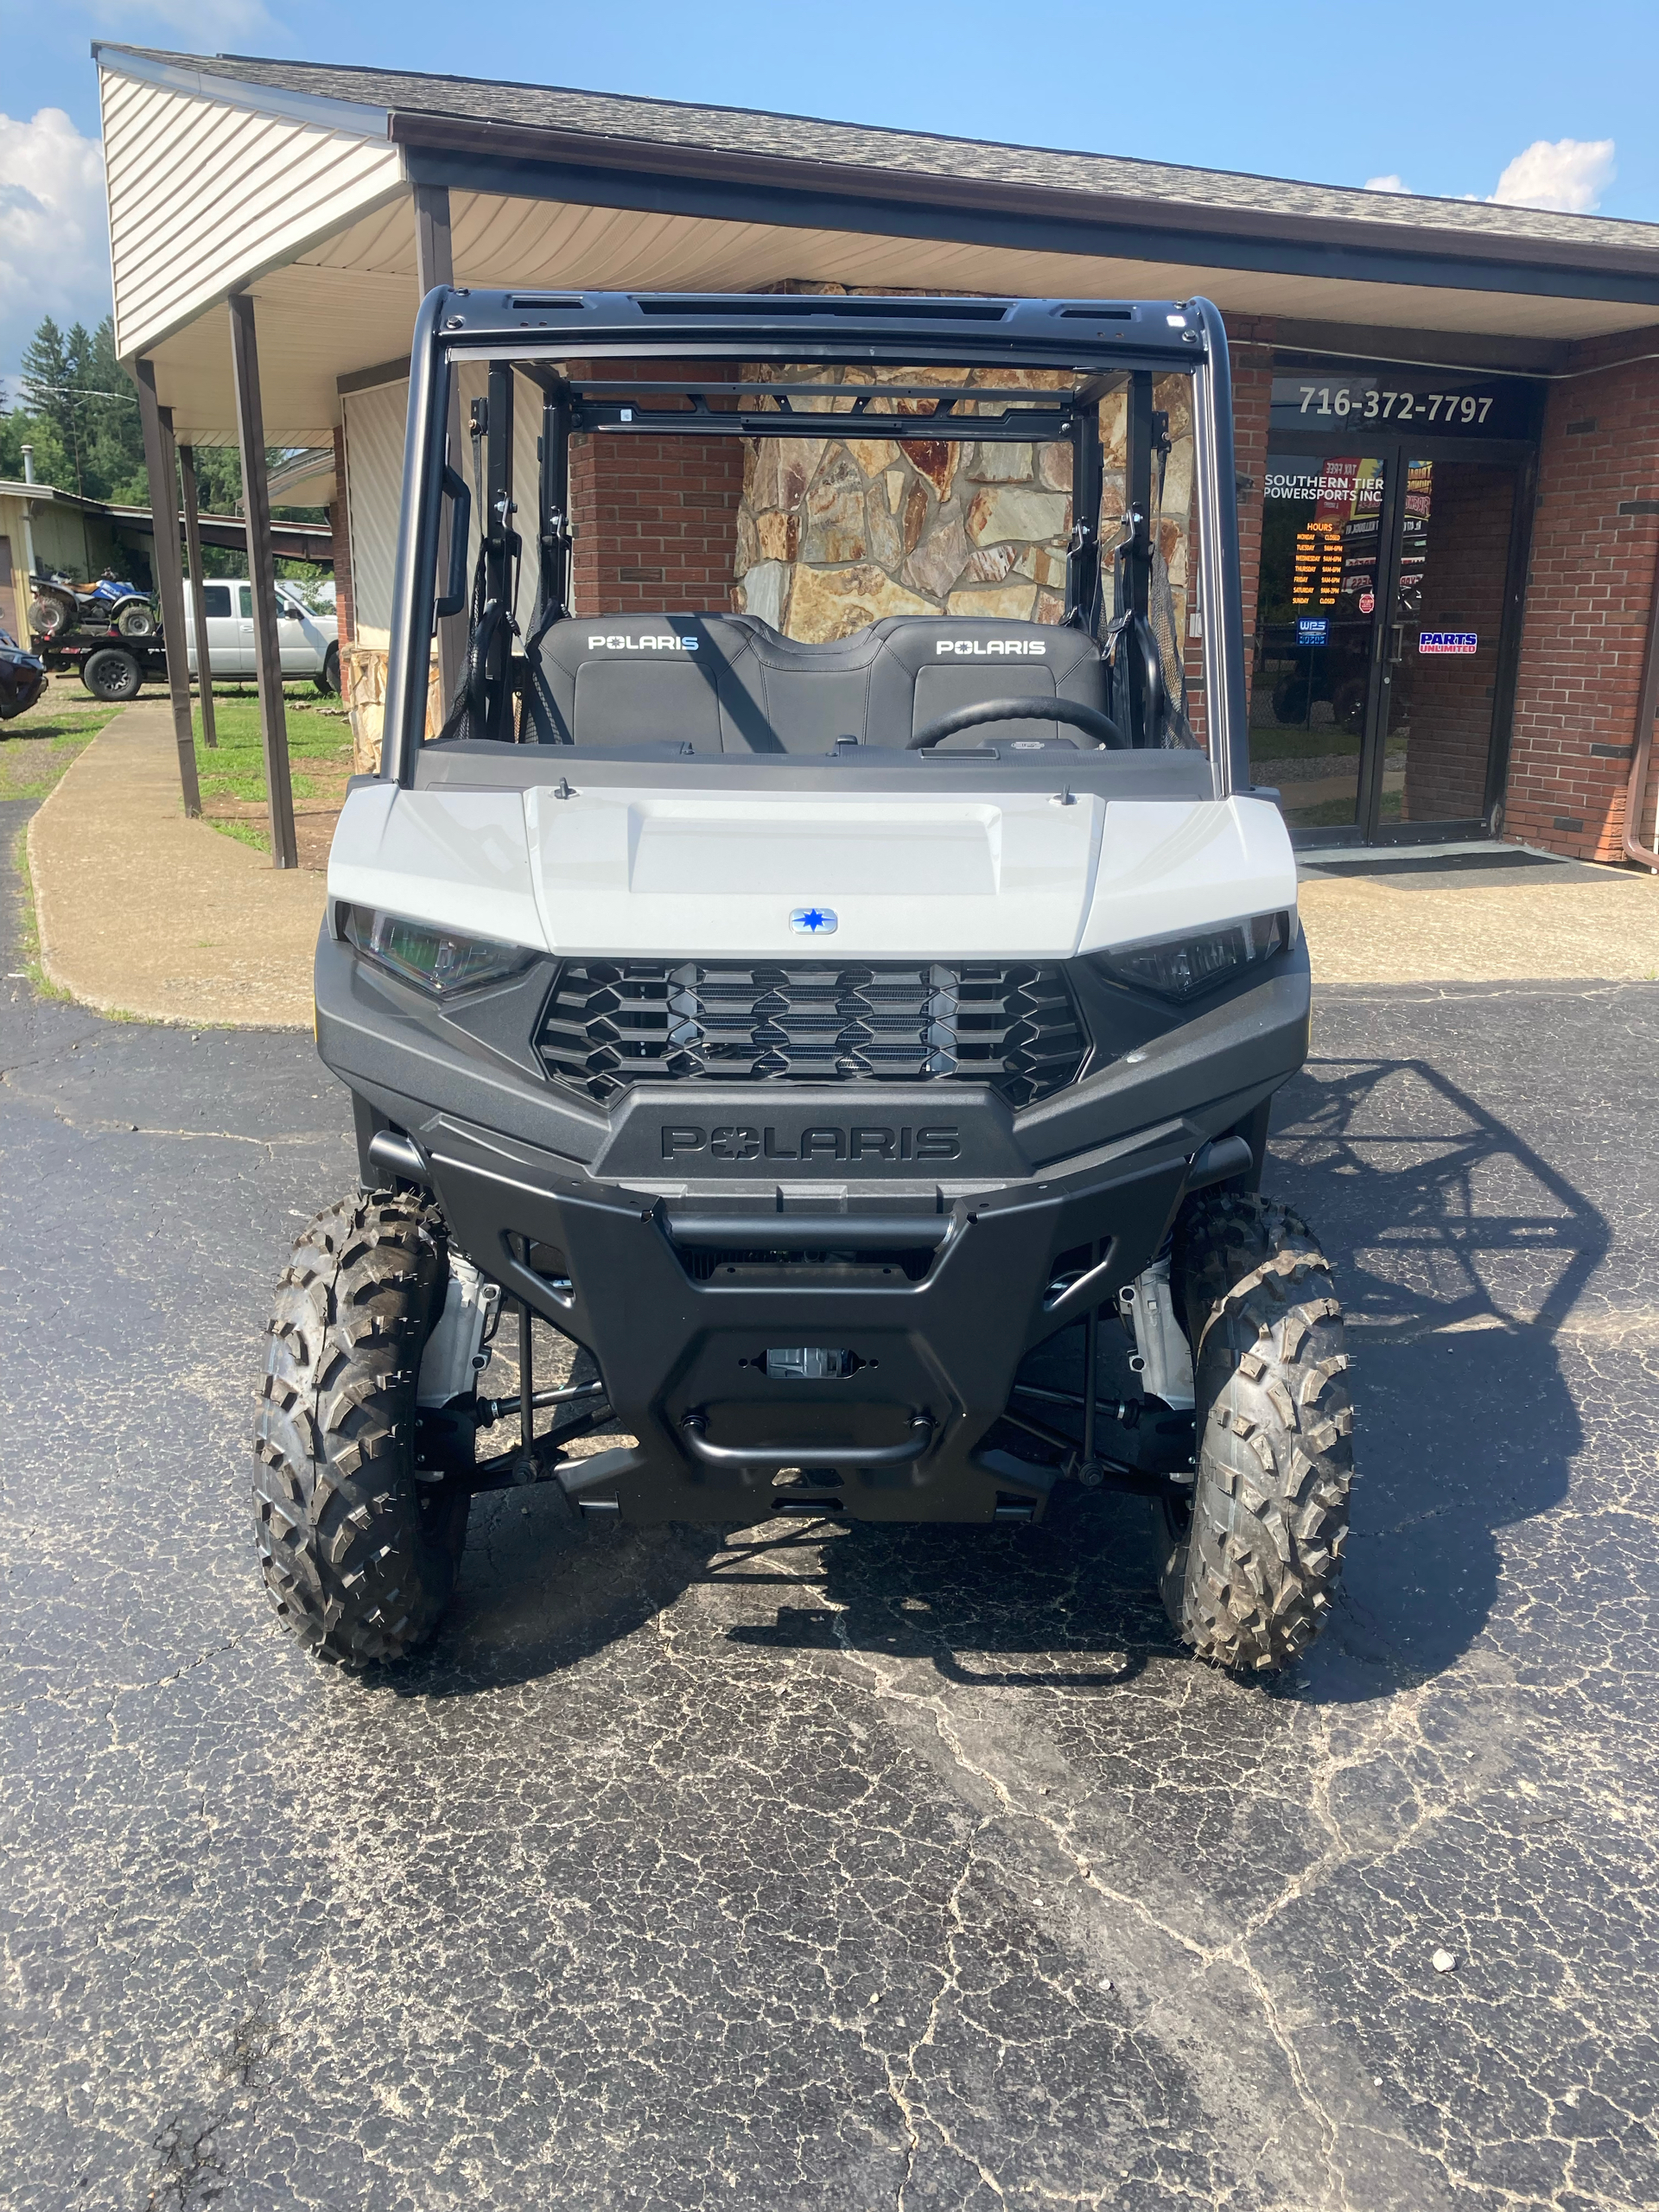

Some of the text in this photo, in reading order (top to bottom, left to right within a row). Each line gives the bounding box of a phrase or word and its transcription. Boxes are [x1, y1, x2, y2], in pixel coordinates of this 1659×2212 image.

[1300, 386, 1494, 423] 716-372-7797
[1264, 474, 1384, 490] SOUTHERN TIER
[1263, 486, 1383, 502] POWERSPORTS INC.
[1307, 523, 1333, 531] HOURS
[1300, 620, 1326, 630] WPS
[588, 636, 699, 651] POLARIS
[1421, 633, 1477, 645] PARTS
[936, 640, 1046, 655] POLARIS
[661, 1126, 962, 1160] POLARIS
